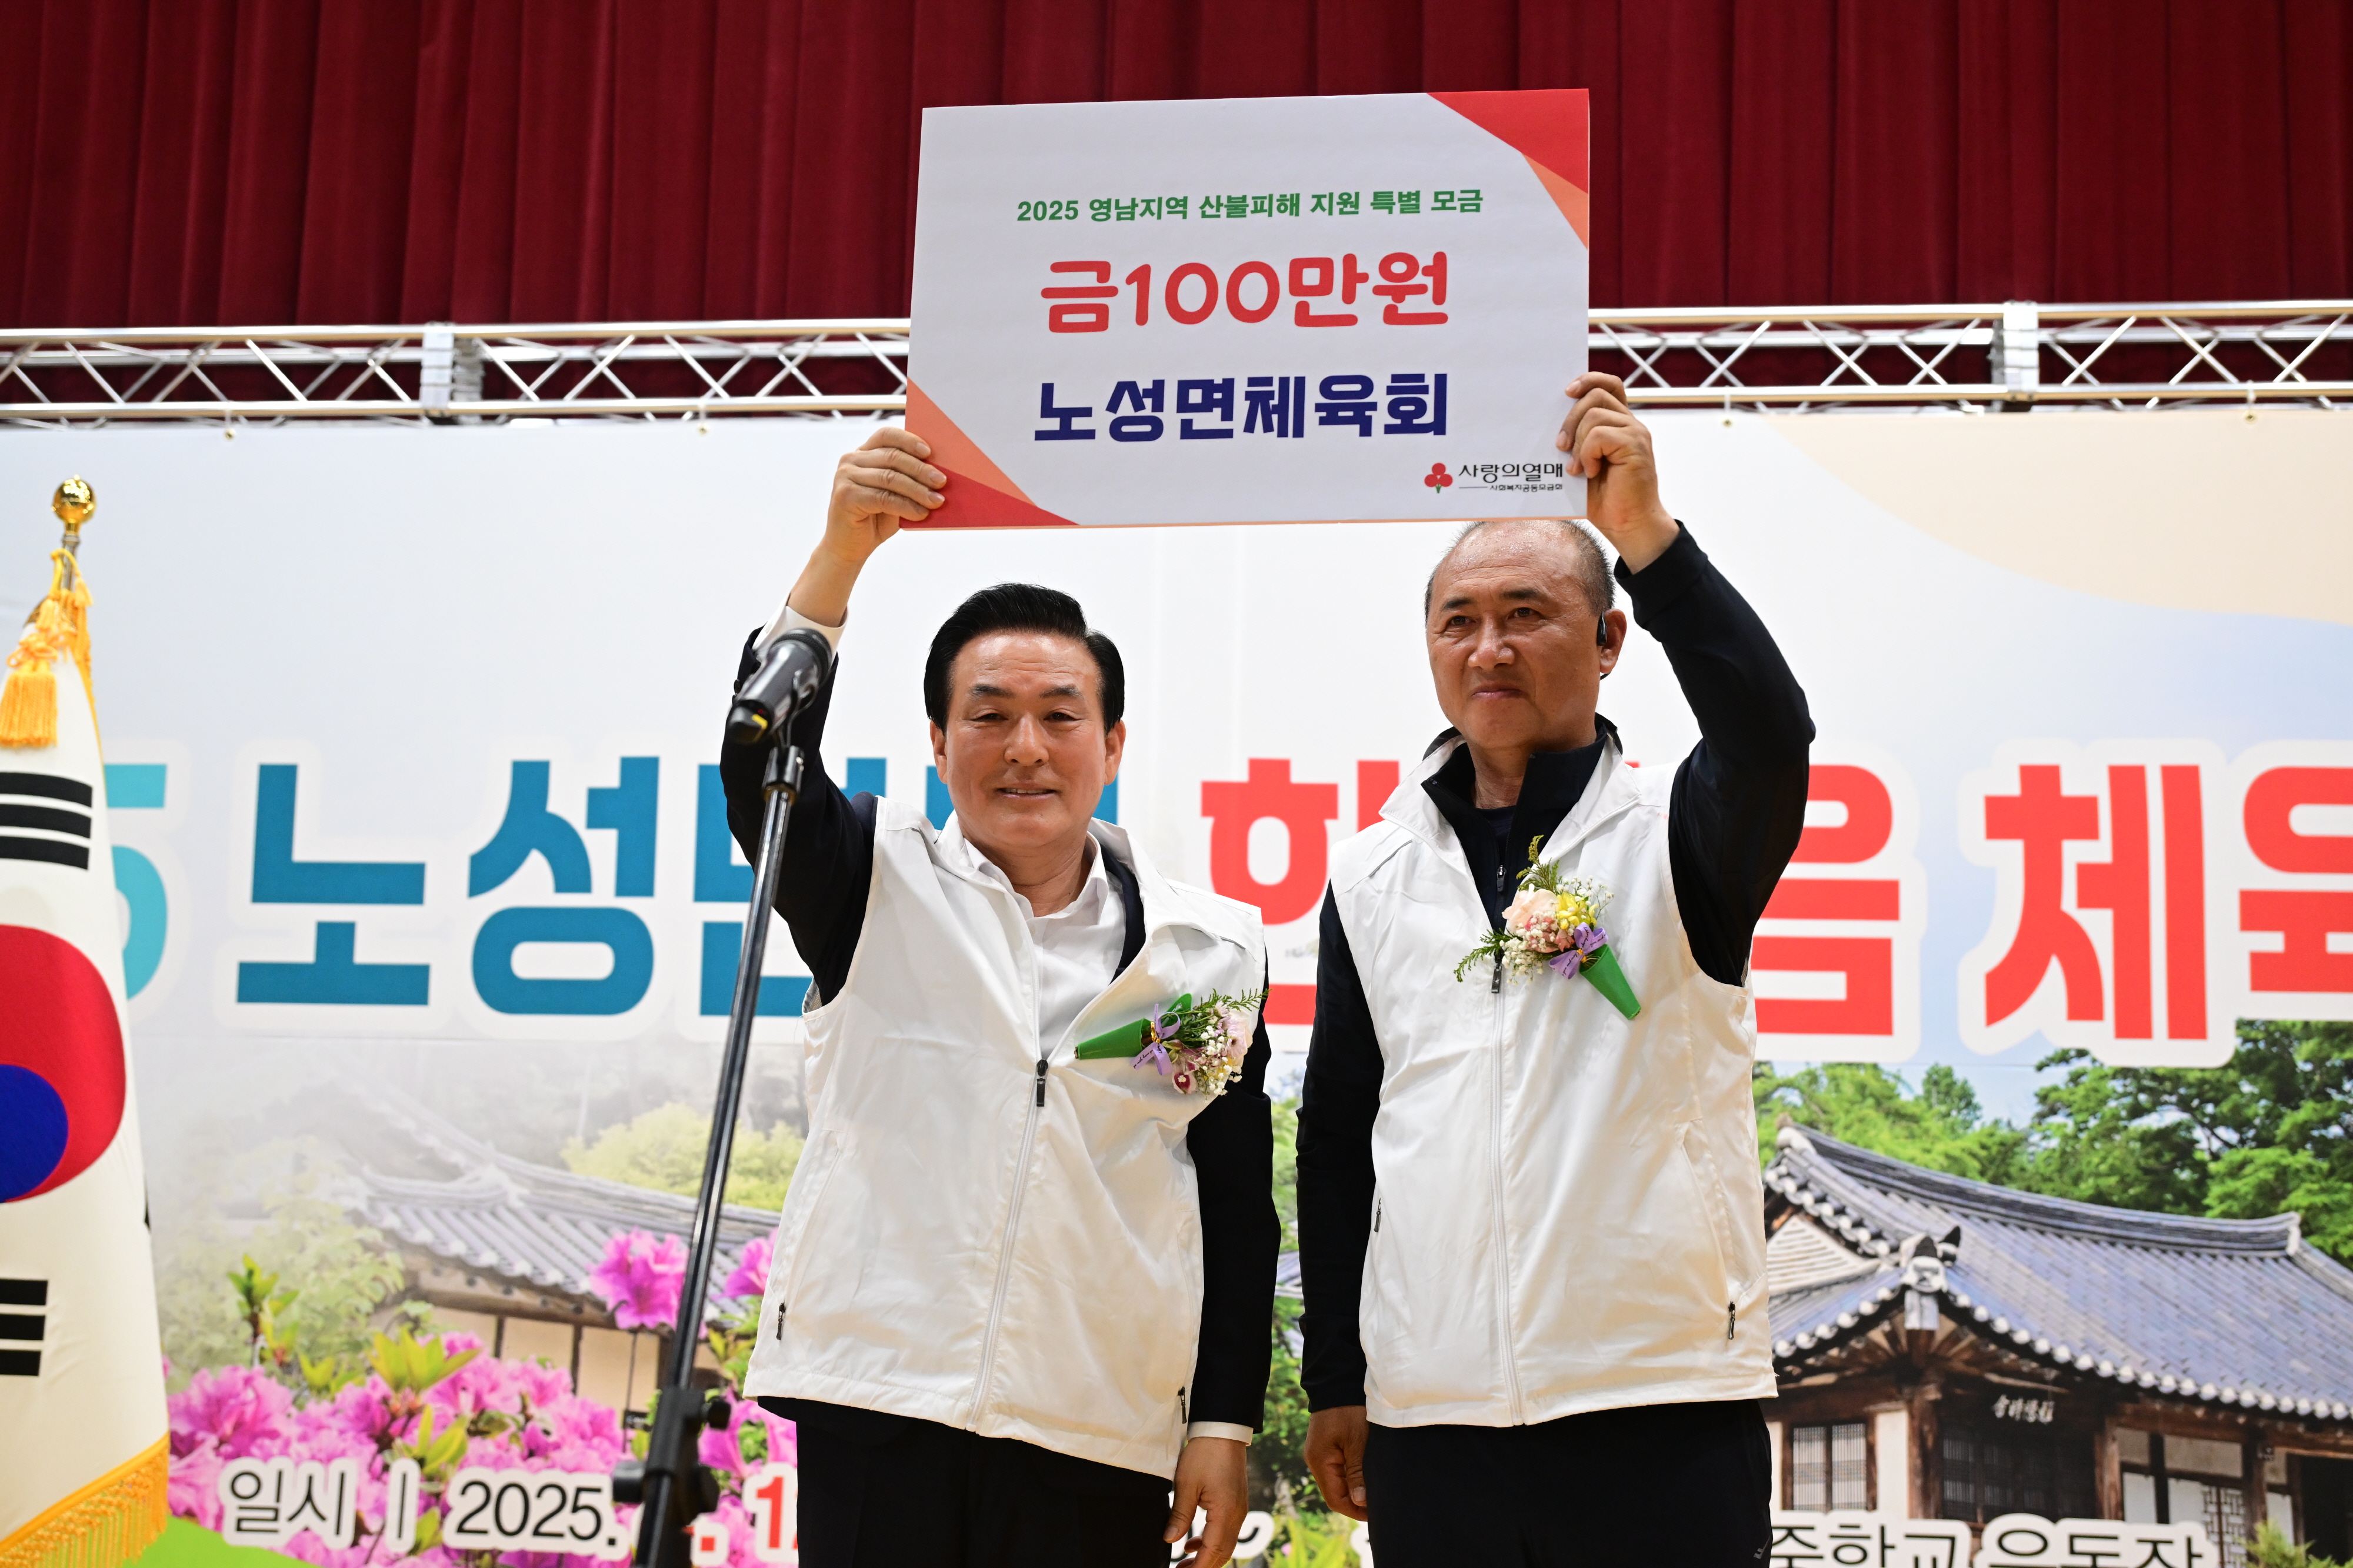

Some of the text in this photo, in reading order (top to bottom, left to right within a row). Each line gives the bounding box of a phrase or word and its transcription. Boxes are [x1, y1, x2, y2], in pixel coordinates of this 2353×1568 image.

[1017, 189, 1484, 222] 2025 영남지역 산불피해 지원 특별 모금
[1040, 251, 1449, 334] 금100만원
[1034, 372, 1448, 442] 노성면체육회
[1458, 463, 1563, 483] 사랑의열매
[230, 1470, 345, 1536] 일시
[455, 1479, 617, 1547] 2025.
